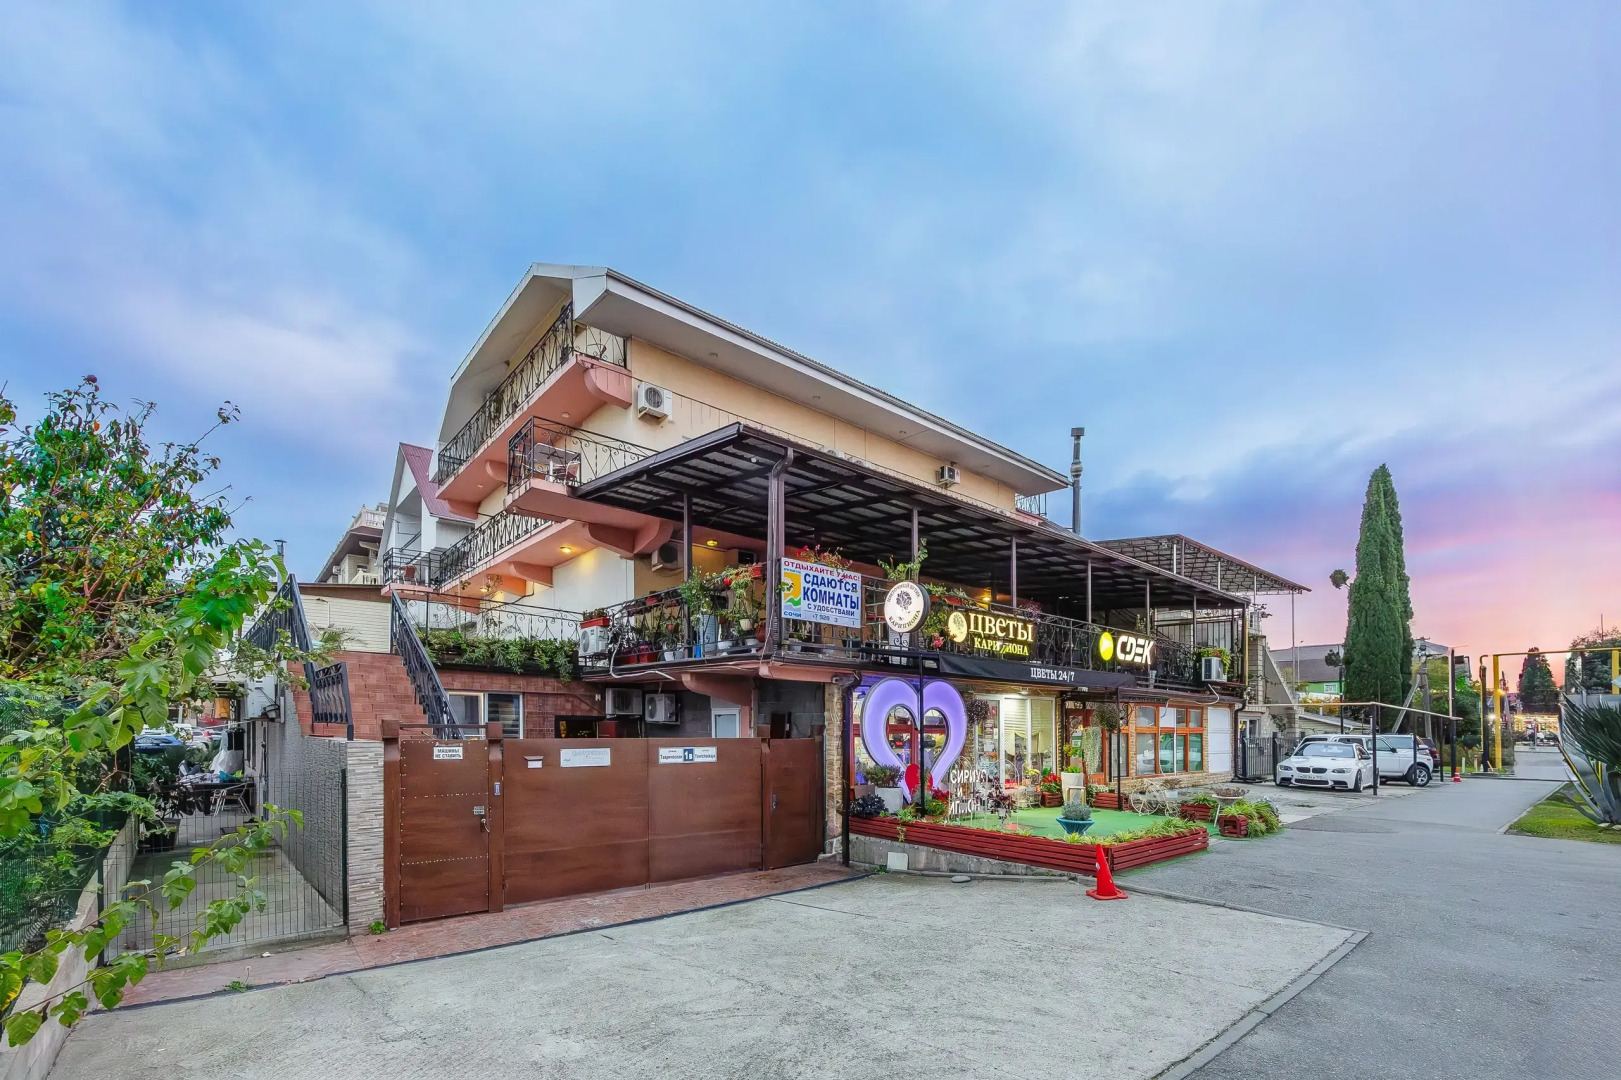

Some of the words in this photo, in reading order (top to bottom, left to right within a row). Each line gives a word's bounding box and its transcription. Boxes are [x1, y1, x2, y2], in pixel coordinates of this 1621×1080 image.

[783, 560, 835, 576] ОТДЫХАЙТЕ
[803, 573, 858, 593] СДАЮТСЯ
[803, 586, 860, 610] КОМНАТЫ
[783, 610, 802, 618] СОЧИ
[813, 603, 855, 617] УДОБСТВАМИ
[1116, 635, 1154, 665] CDEK
[1030, 667, 1058, 680] ЦВЕТЫ
[1058, 670, 1075, 683] 24/7
